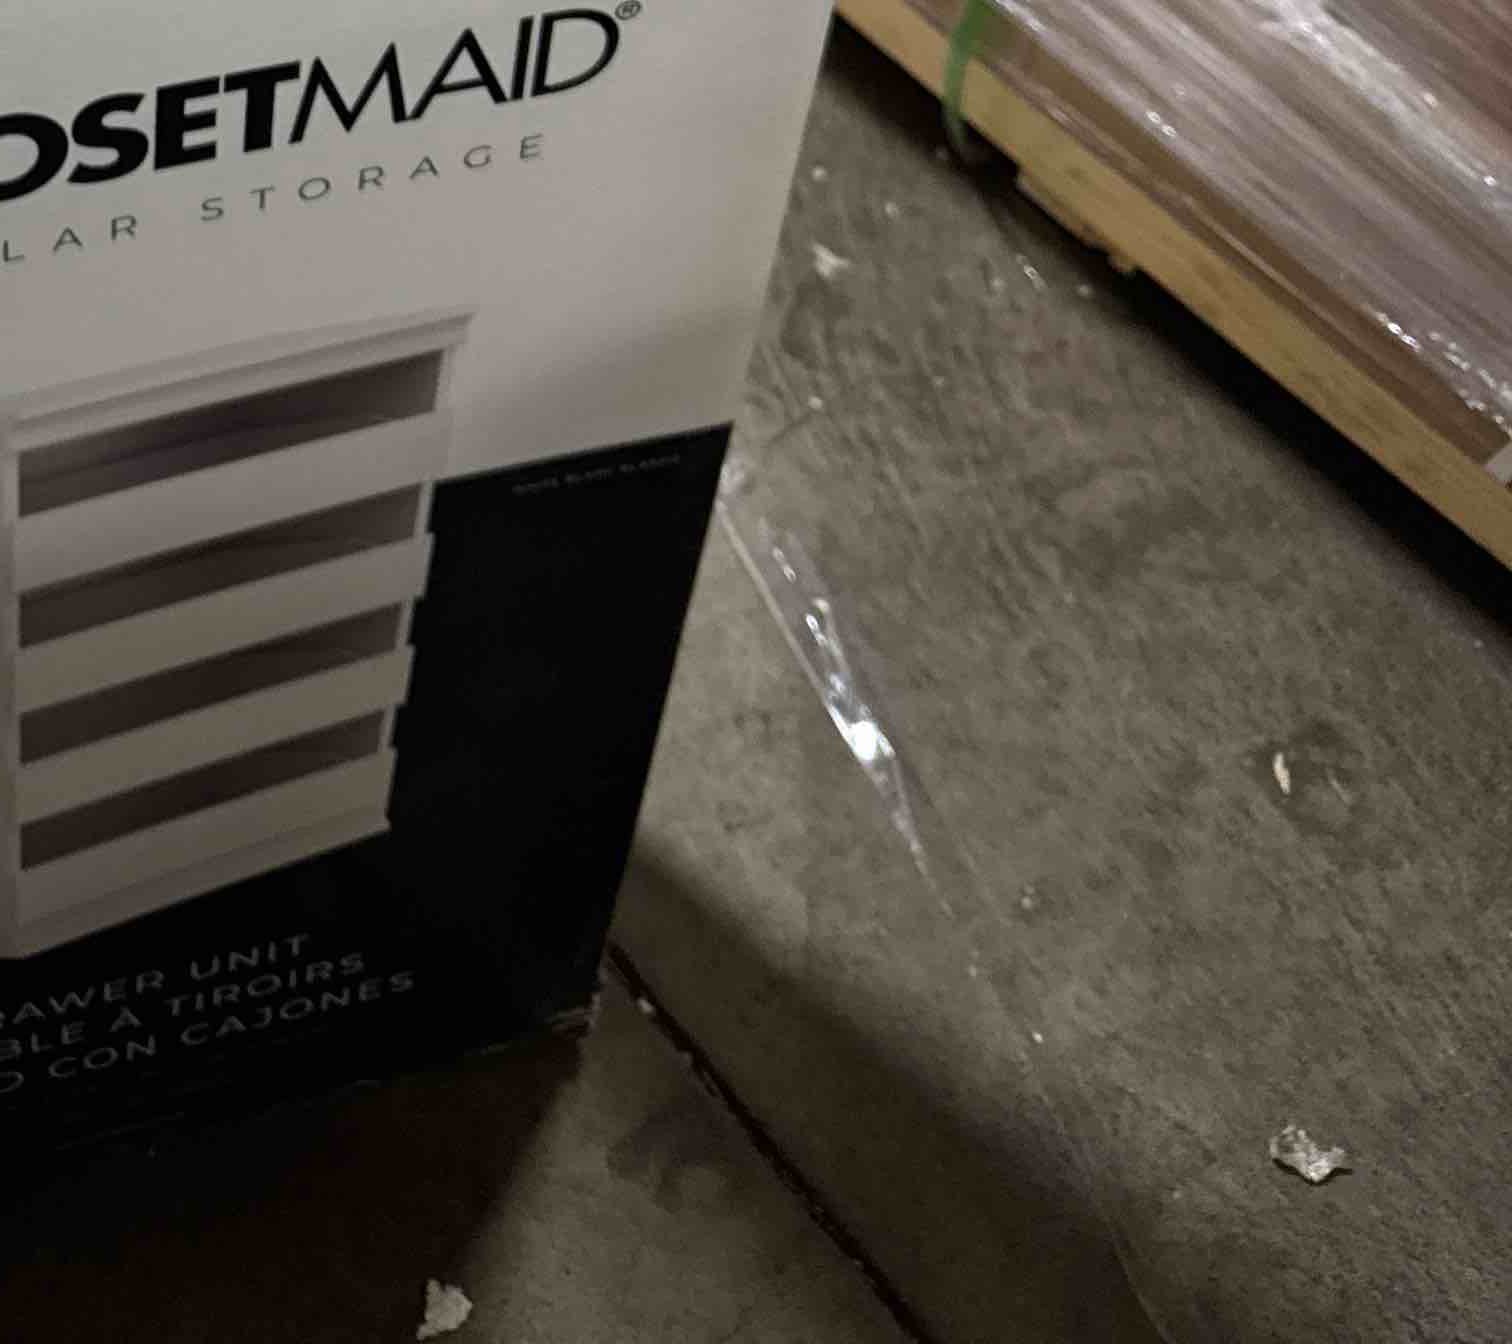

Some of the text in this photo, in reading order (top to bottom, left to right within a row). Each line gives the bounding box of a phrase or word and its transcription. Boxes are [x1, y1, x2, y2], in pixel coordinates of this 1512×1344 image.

[201, 133, 544, 223] STORAGE
[164, 952, 367, 1018] TIROIRS
[189, 932, 311, 981] UNIT
[48, 1034, 158, 1081] CON
[180, 970, 418, 1047] CAJONES
